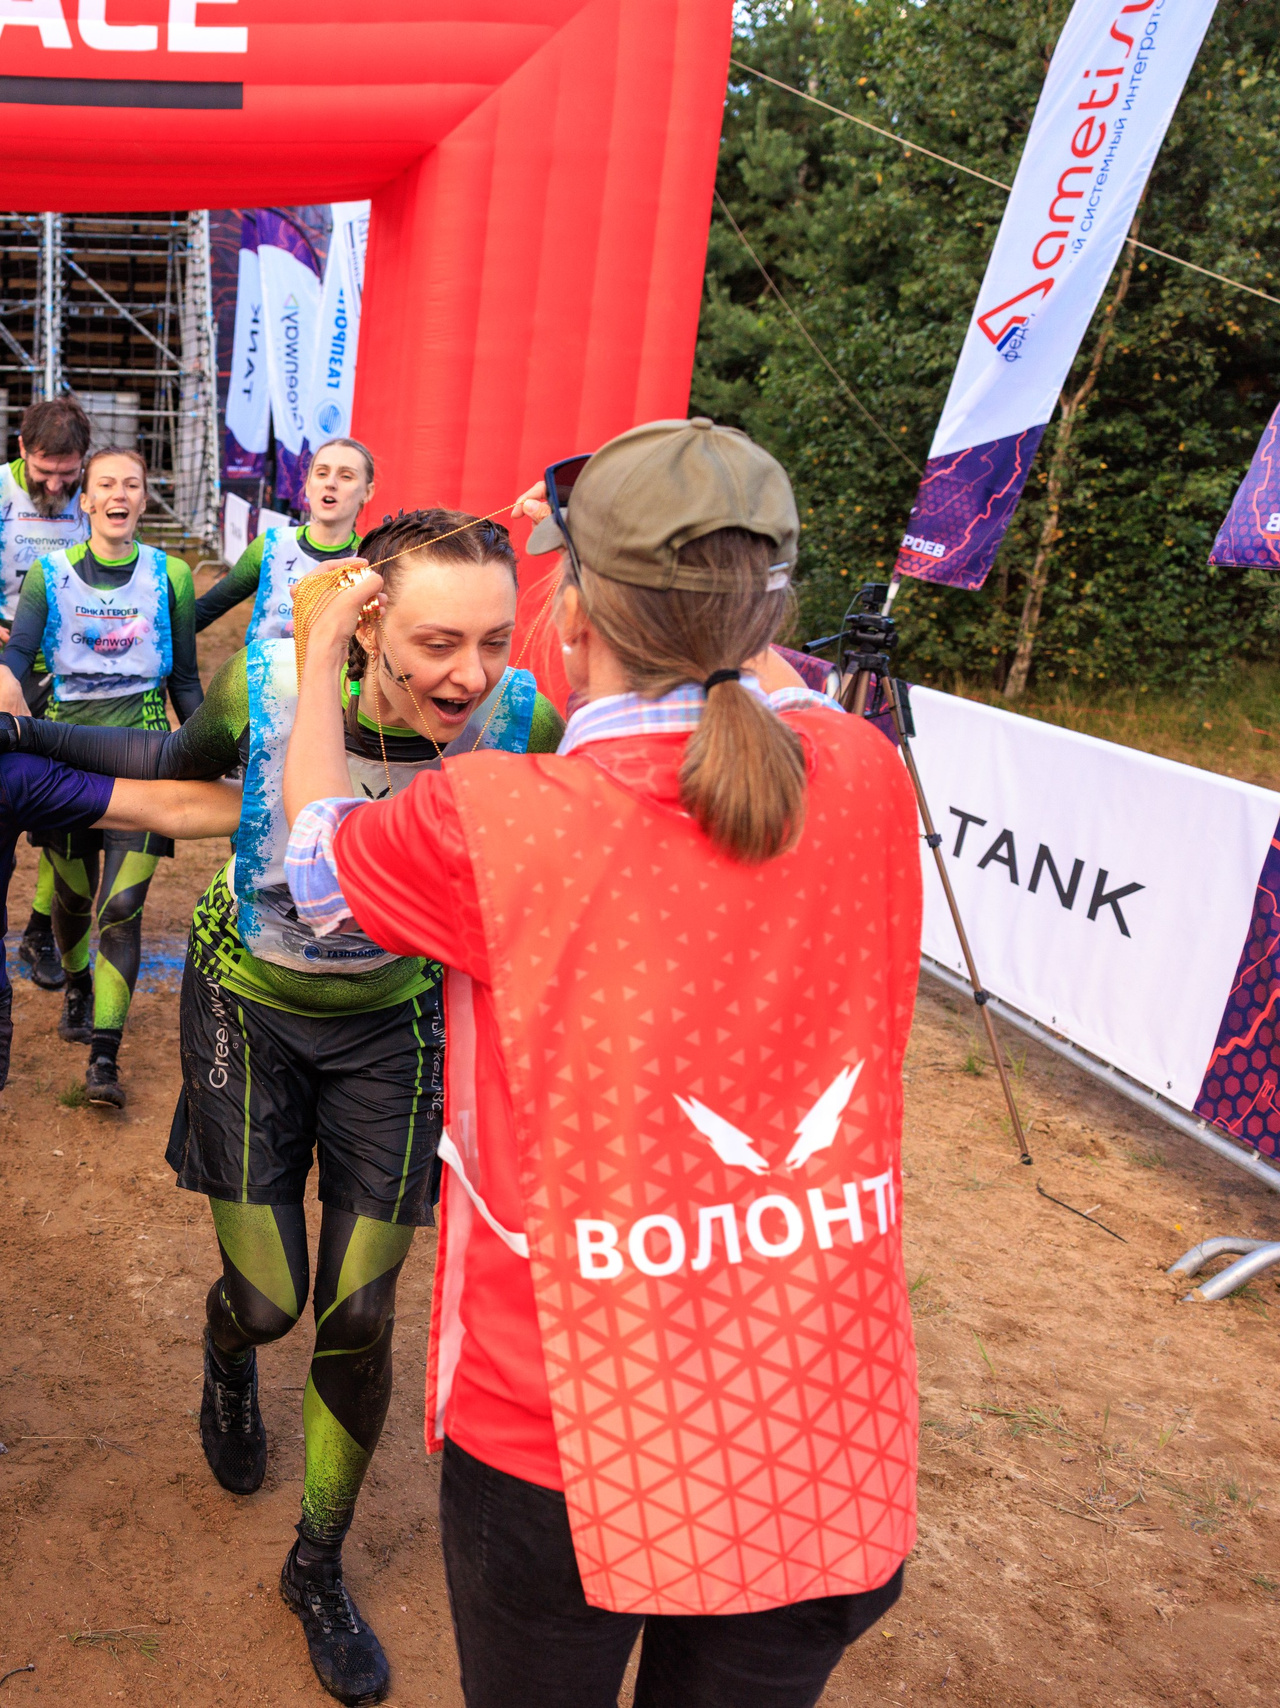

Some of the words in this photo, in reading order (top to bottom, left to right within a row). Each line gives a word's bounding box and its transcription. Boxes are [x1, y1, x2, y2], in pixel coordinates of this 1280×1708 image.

[14, 534, 70, 549] Greenway
[75, 605, 104, 616] ГОНКА
[106, 606, 138, 616] ГЕРОЕВ
[71, 632, 134, 648] Greenway
[948, 805, 1147, 939] TANK
[575, 1171, 896, 1280] ВОЛОНТ
